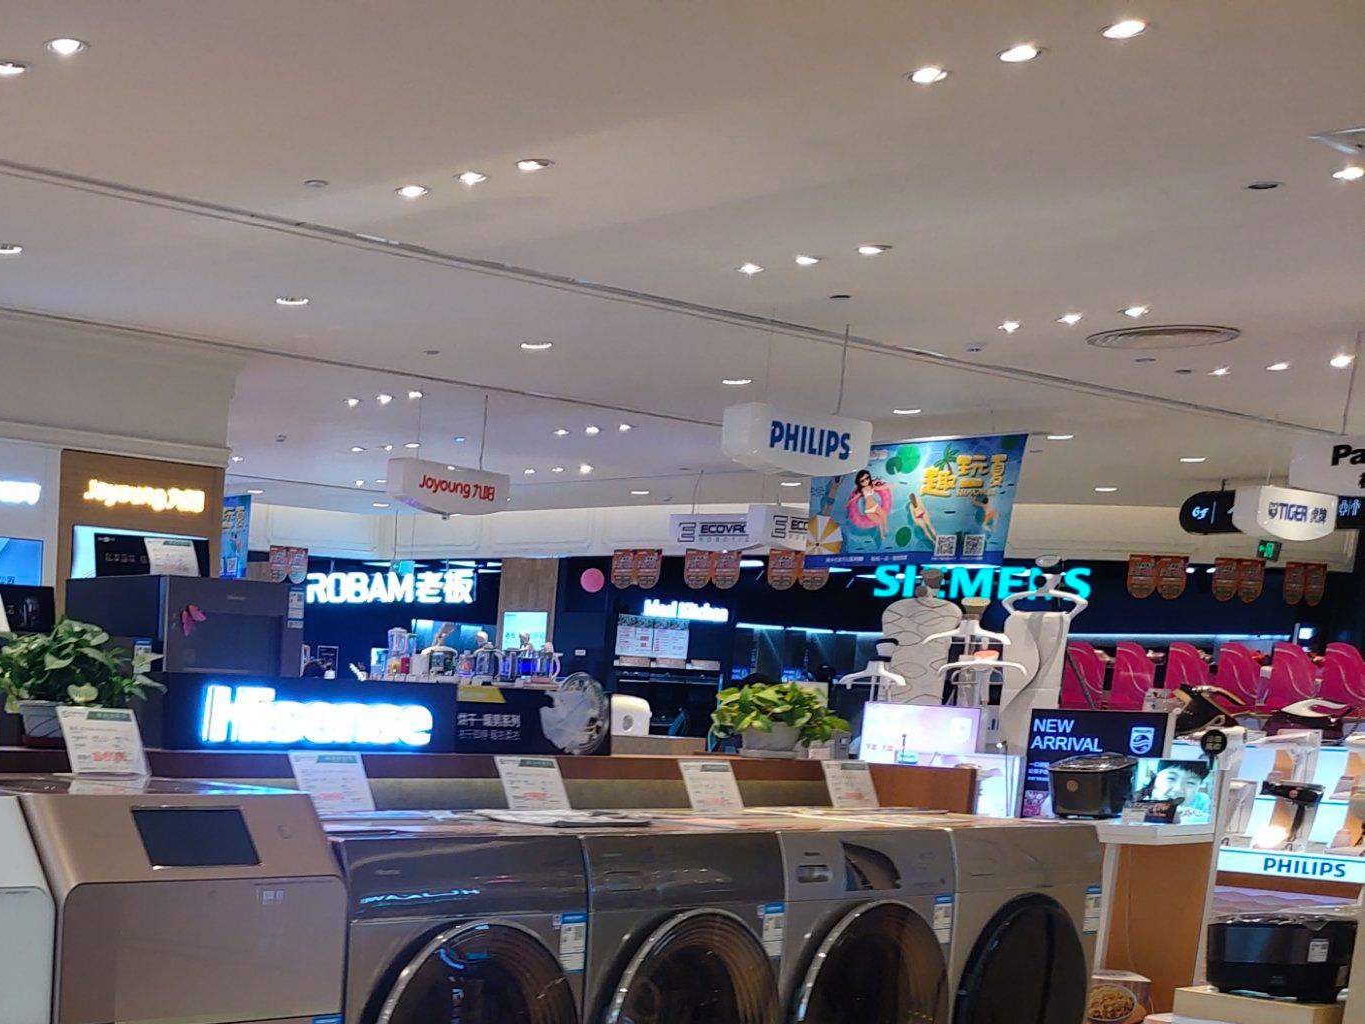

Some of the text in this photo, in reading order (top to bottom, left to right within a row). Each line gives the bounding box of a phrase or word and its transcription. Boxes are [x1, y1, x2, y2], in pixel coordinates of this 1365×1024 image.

[769, 420, 852, 461] PHILIPS
[872, 564, 1092, 601] SIMES
[201, 684, 435, 745] Hisense
[1034, 718, 1075, 733] NEW
[1030, 735, 1104, 752] ARRIVAL
[1262, 857, 1347, 878] PHILIPS
